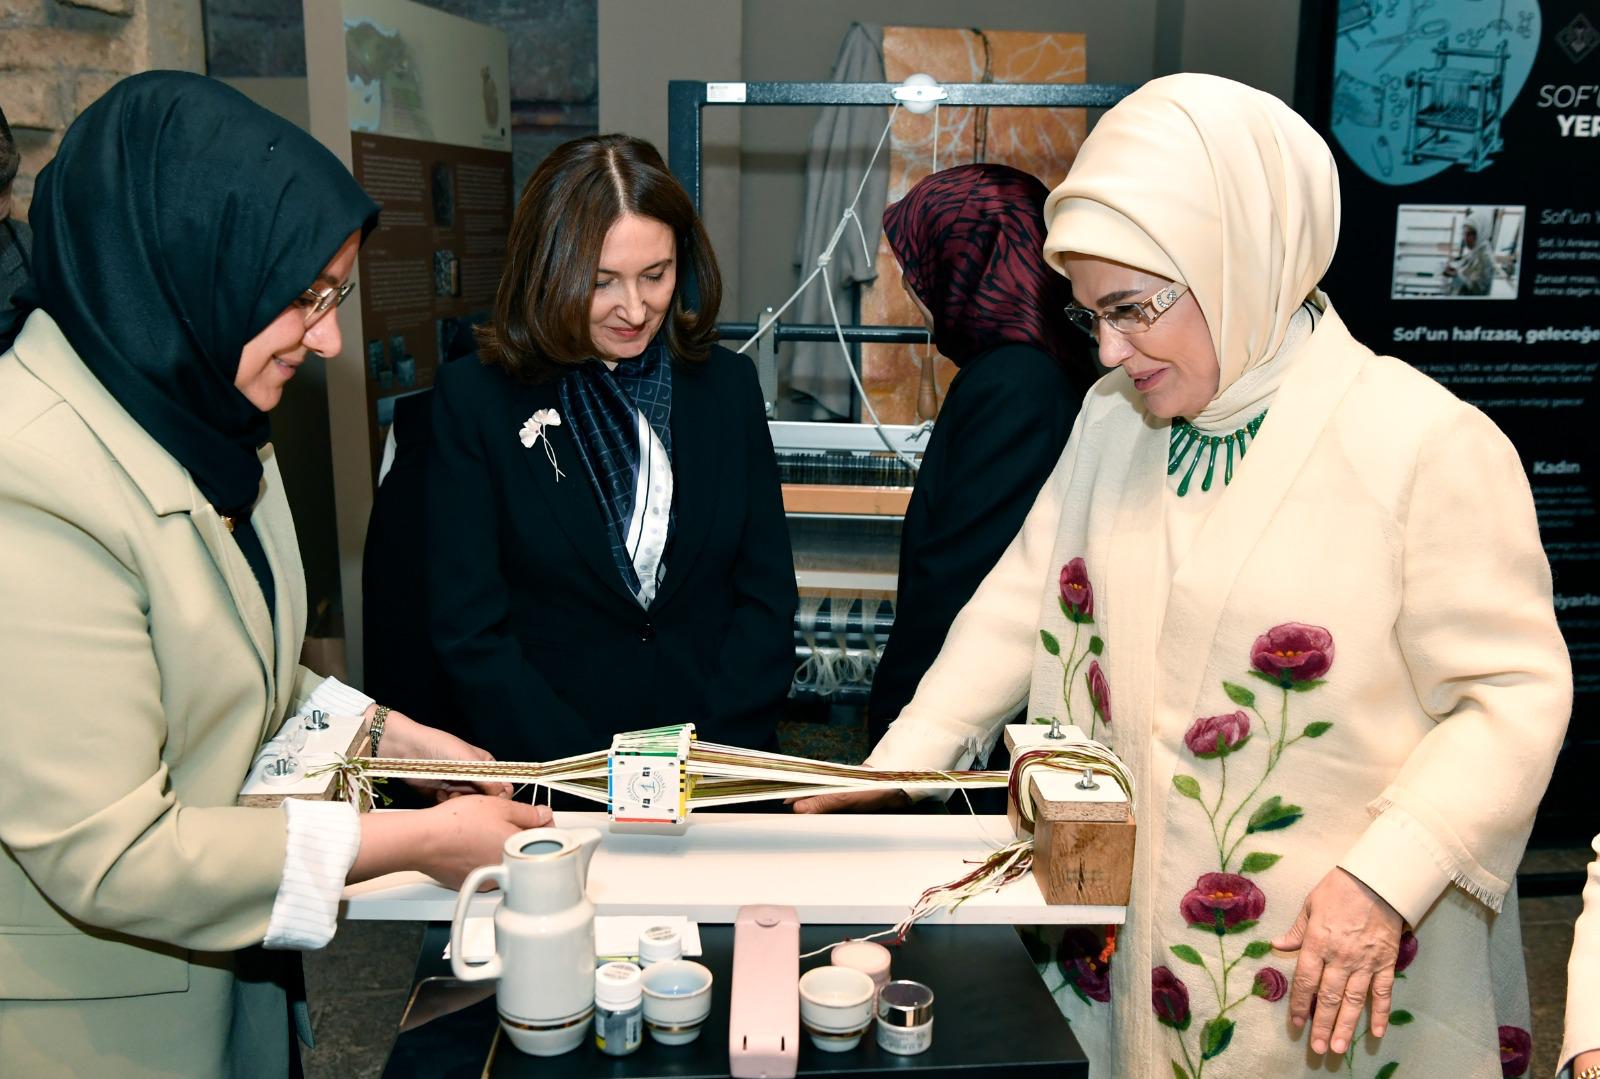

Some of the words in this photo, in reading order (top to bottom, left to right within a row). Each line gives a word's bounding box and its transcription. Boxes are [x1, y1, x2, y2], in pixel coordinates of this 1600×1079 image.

[1536, 84, 1600, 108] SOF'
[1393, 327, 1448, 342] Sof'un
[1451, 325, 1523, 344] hafızası,
[1533, 460, 1581, 475] Kadın
